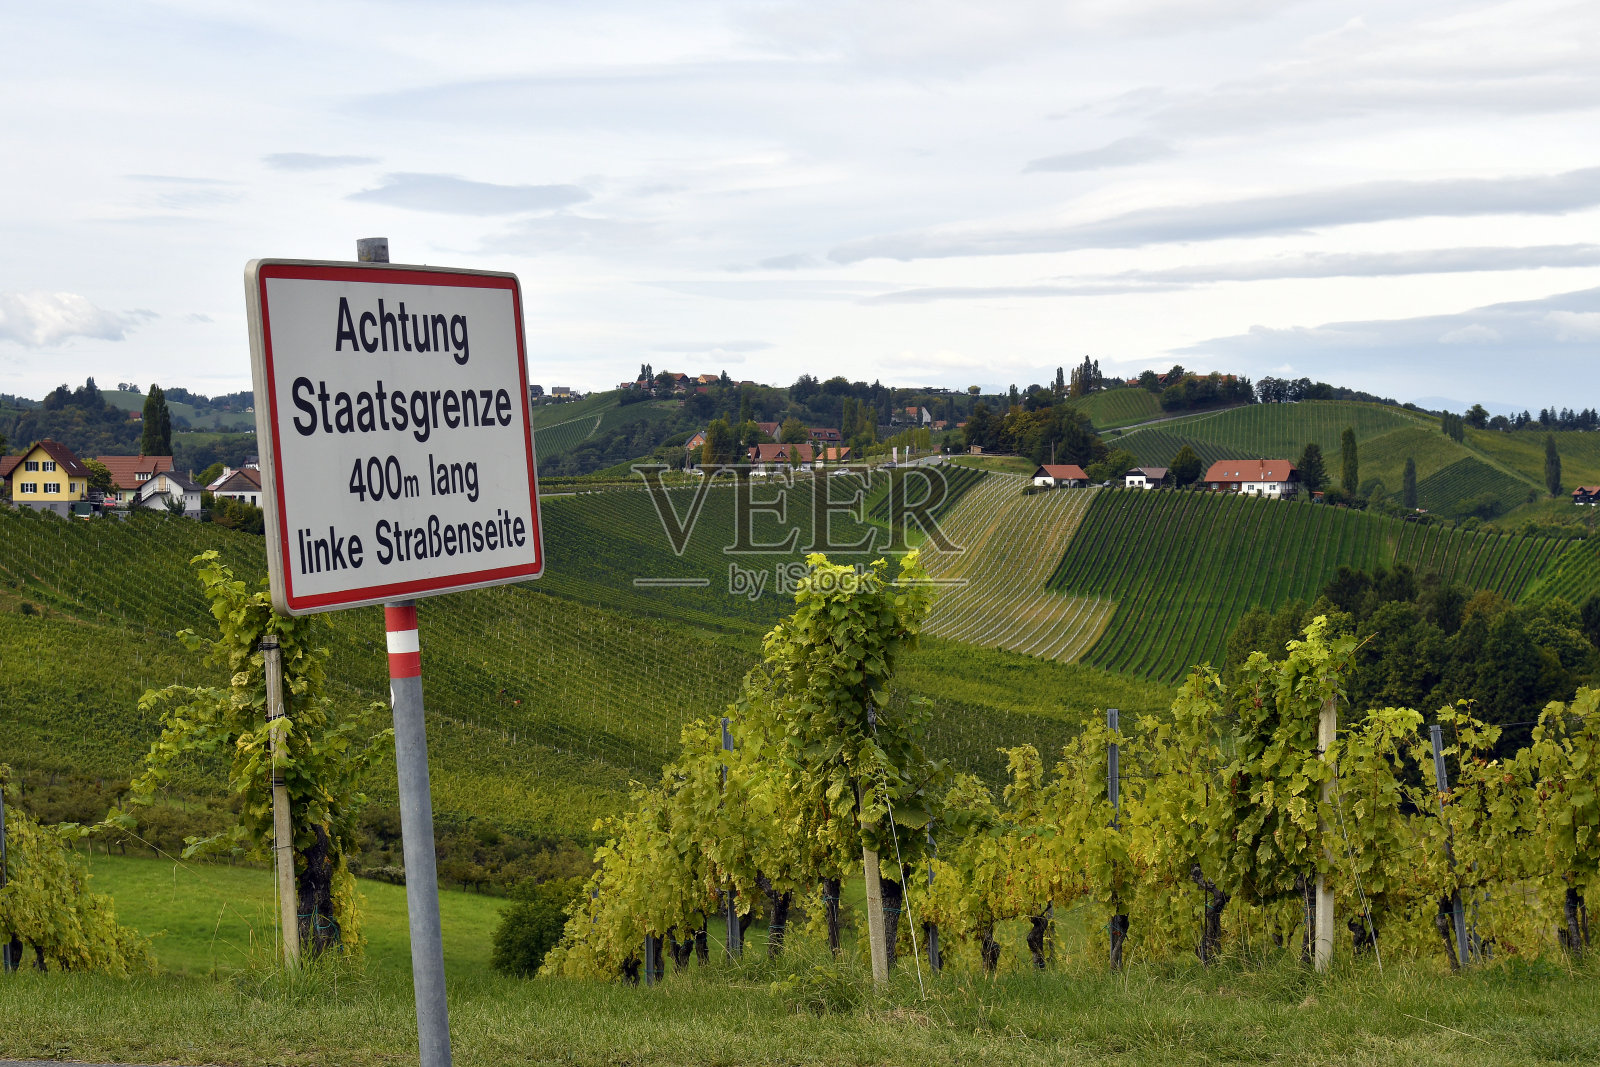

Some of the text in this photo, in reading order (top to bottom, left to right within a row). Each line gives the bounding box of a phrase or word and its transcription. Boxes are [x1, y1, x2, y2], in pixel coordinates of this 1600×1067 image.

[335, 296, 470, 366] Achtung
[291, 376, 512, 443] Staatsgrenze
[348, 453, 480, 503] 400m lang
[297, 508, 526, 575] linke Straßenseite
